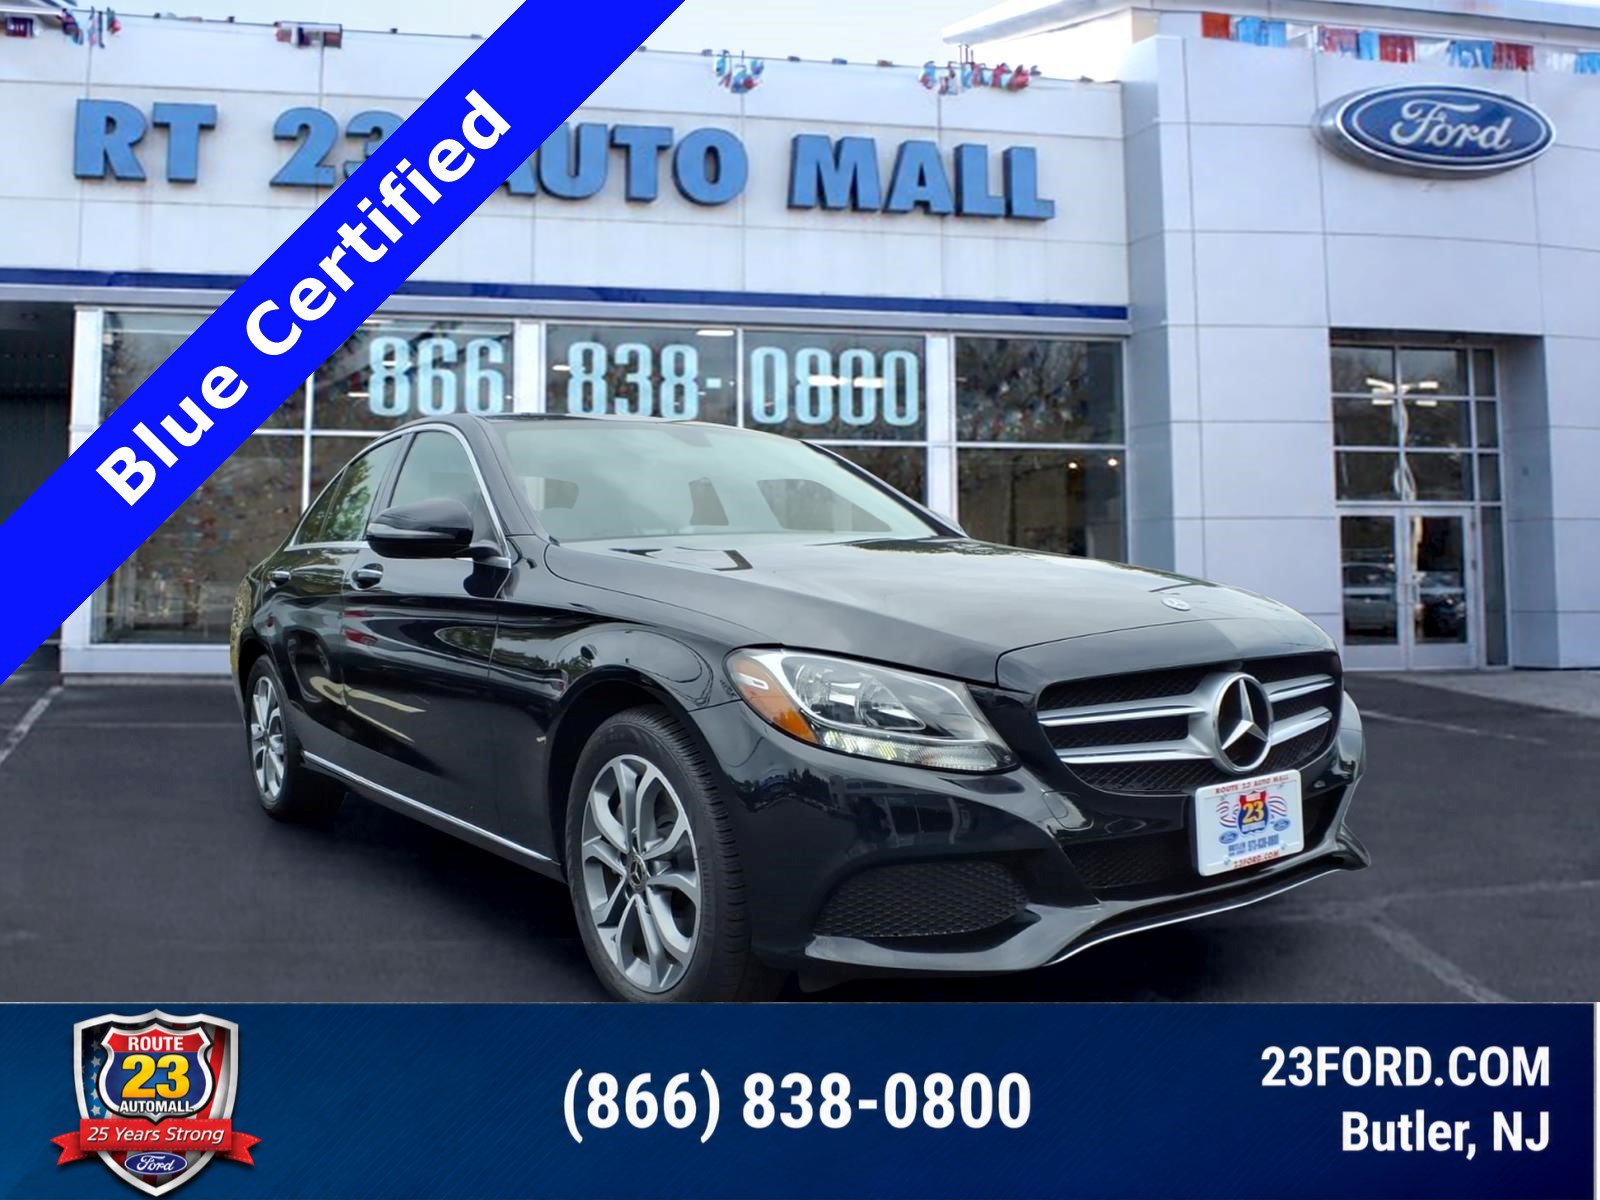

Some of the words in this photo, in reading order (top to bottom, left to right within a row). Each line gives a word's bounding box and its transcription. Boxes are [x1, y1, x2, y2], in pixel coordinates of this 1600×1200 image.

[73, 98, 217, 184] RT
[790, 135, 1055, 221] MALL
[1390, 98, 1513, 154] Ford
[368, 336, 506, 417] 866
[1242, 800, 1265, 823] 23
